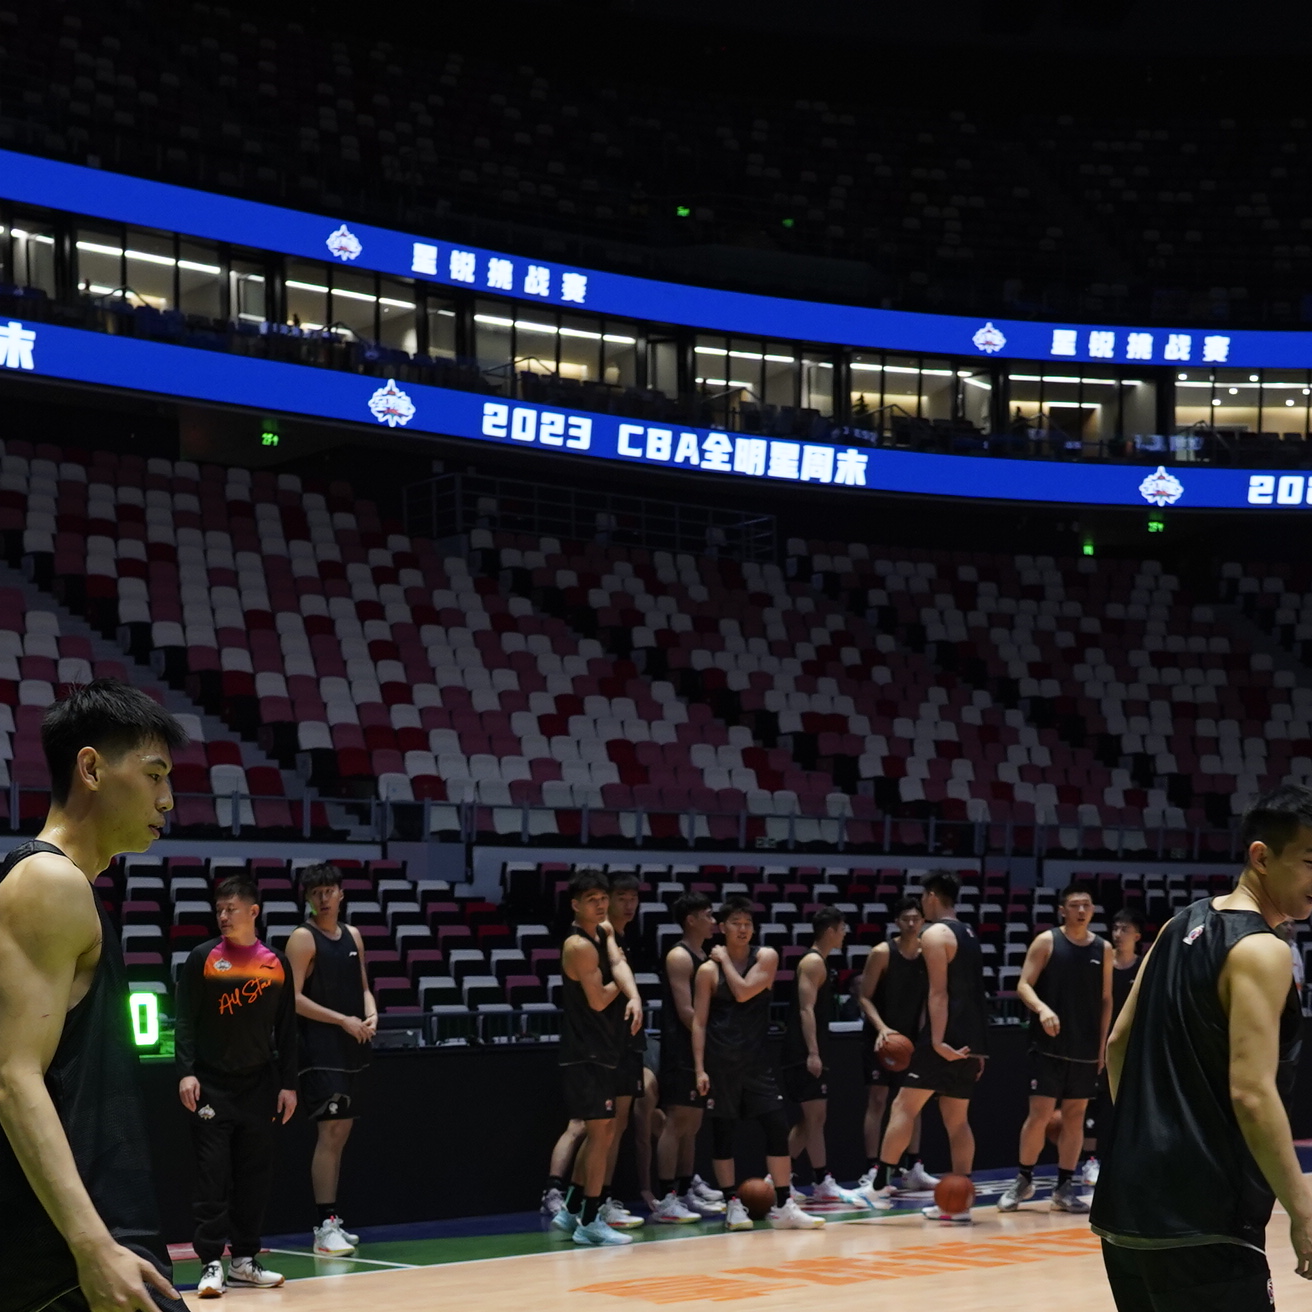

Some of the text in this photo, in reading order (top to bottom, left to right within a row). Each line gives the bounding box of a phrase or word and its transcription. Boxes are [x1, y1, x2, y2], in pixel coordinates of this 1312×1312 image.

[411, 242, 588, 304] 星锐挑战赛
[1050, 329, 1231, 363] 星锐挑战赛
[482, 402, 593, 450] 2023
[617, 423, 869, 486] CBA全明星周末
[218, 976, 272, 1015] All Star
